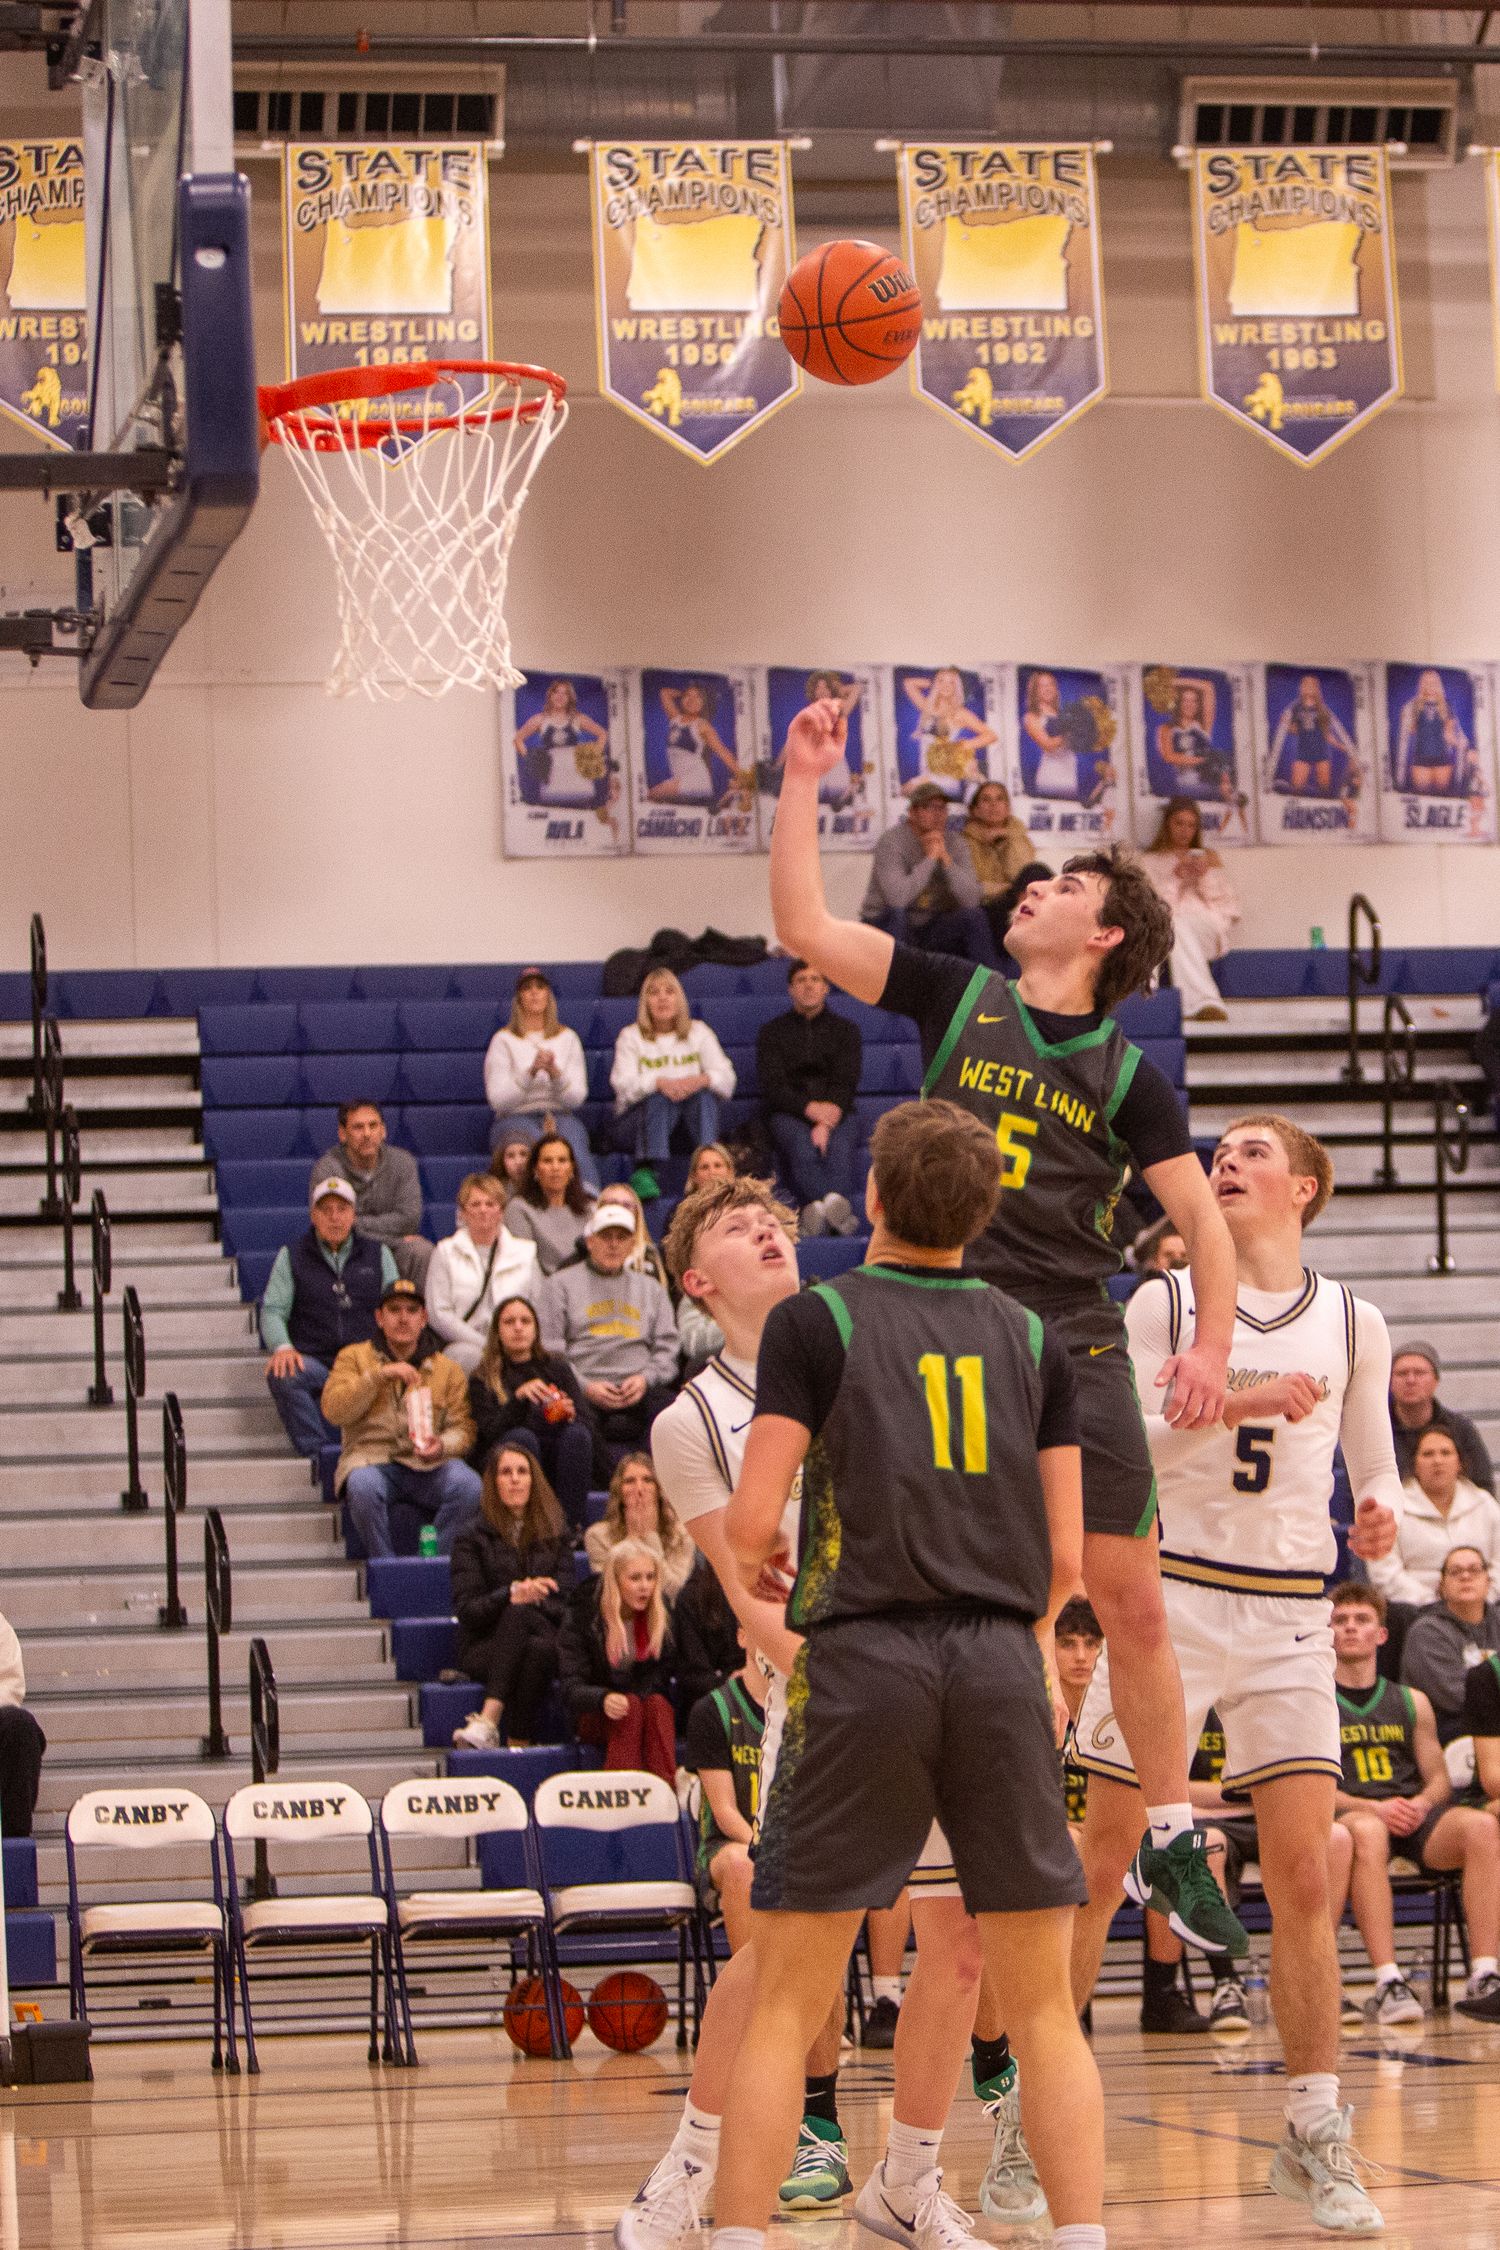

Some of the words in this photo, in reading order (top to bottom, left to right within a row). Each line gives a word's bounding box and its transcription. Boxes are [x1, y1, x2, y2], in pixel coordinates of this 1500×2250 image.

[297, 150, 476, 194] STATE
[606, 148, 779, 193] STATE
[915, 150, 1086, 192] STATE
[1207, 155, 1377, 197] STATE
[0, 178, 84, 224] HAMP
[606, 180, 782, 229] CHAMPIONS
[915, 181, 1088, 229] CHAMPIONS
[1209, 185, 1381, 235] CHAMPIONS
[300, 320, 478, 345] WRESTLING
[922, 316, 1094, 340] WRESTLING
[1213, 320, 1387, 346] WRESTLING
[975, 341, 1047, 365] 1962
[1266, 348, 1338, 371] 1963
[958, 1056, 1033, 1101] WEST
[1033, 1082, 1096, 1133] LINN
[996, 1112, 1038, 1190] 5
[918, 1353, 988, 1474] 11
[1232, 1426, 1276, 1494] 5
[1341, 1724, 1367, 1744] EST
[1352, 1746, 1393, 1783] 10
[94, 1803, 189, 1825] CANBY
[252, 1797, 346, 1819] CANBY
[406, 1793, 501, 1815] CANBY
[557, 1788, 652, 1809] CANBY
